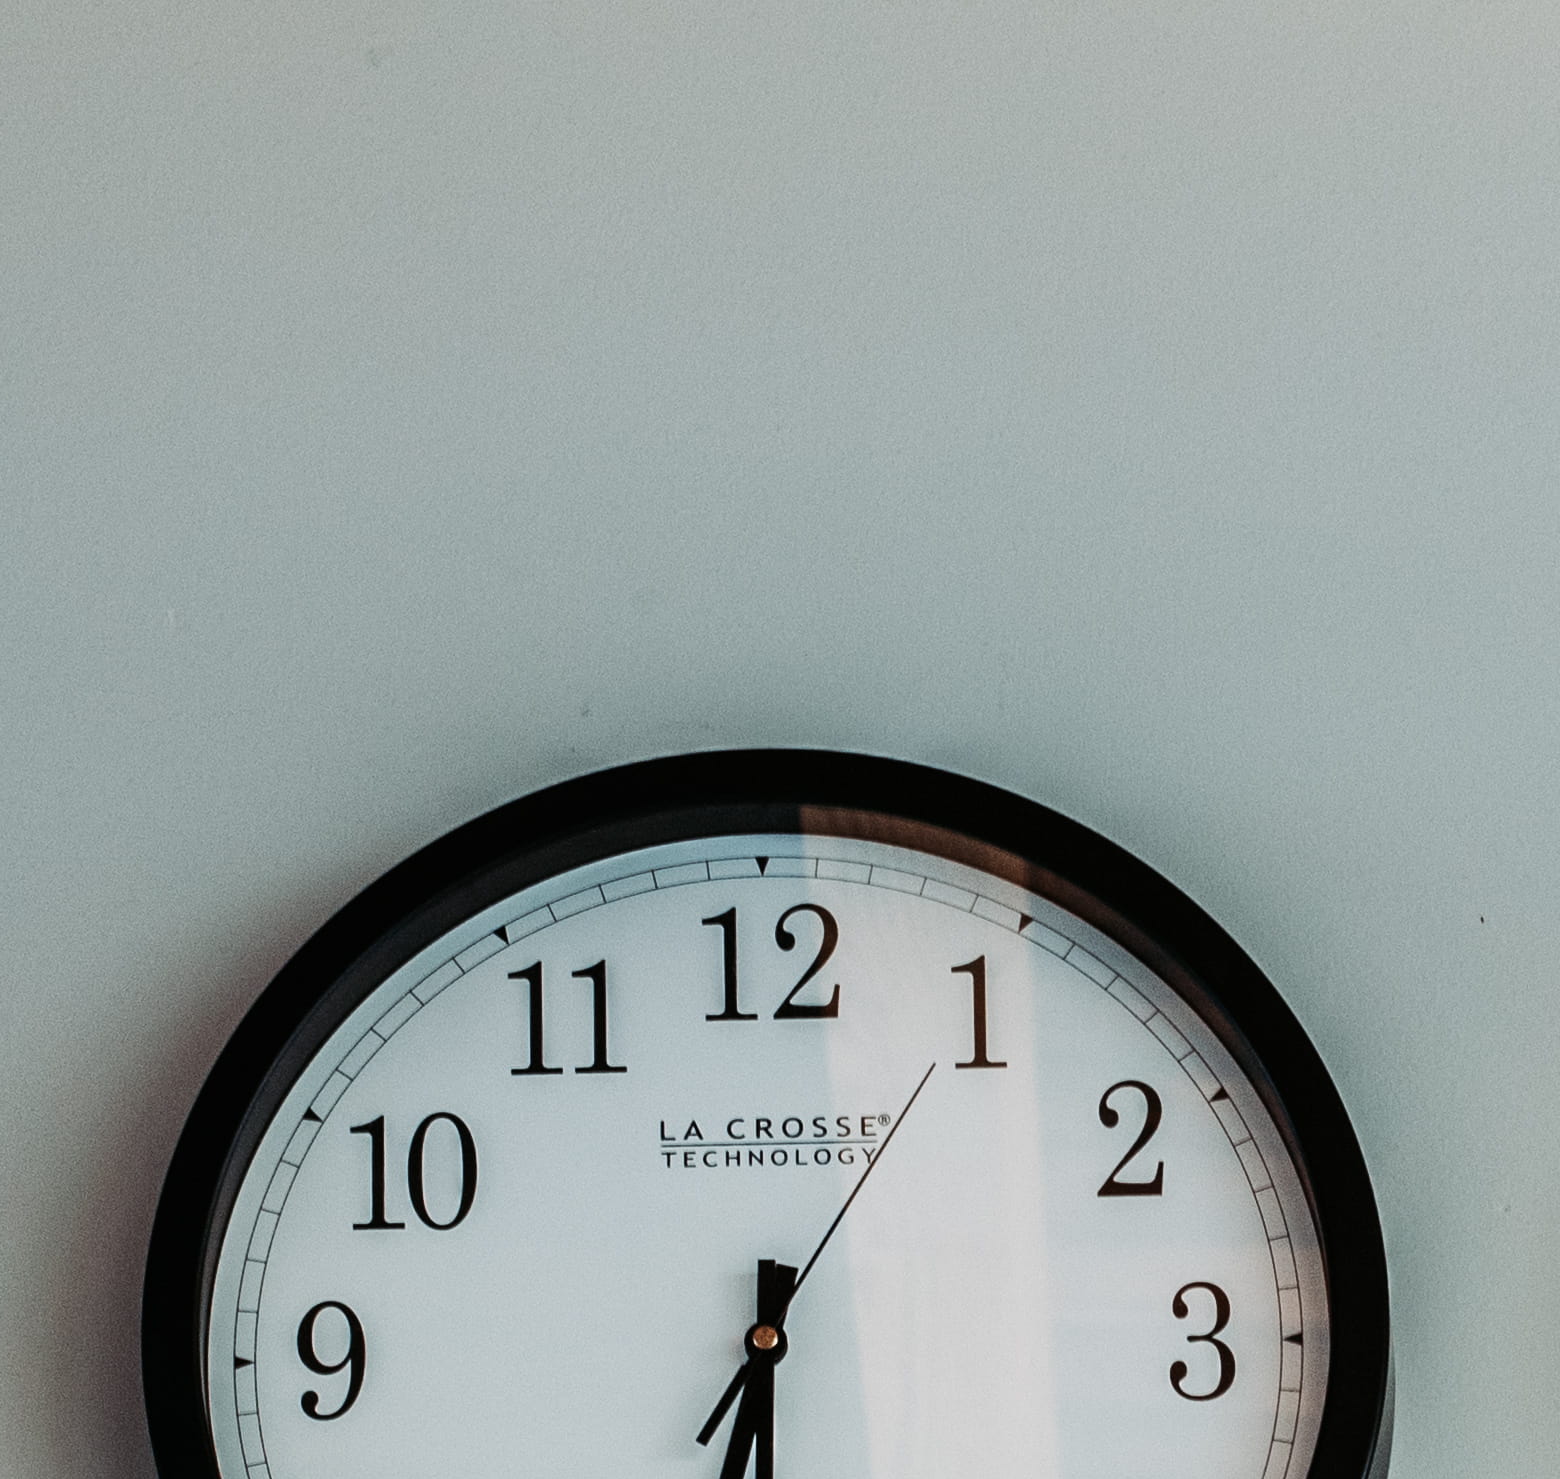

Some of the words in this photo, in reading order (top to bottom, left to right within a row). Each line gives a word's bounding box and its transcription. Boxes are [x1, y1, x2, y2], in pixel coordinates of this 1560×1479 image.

[508, 959, 627, 1075] 11
[702, 903, 840, 1021] 12
[951, 955, 1007, 1069] 1
[350, 1112, 477, 1230] 10
[660, 1120, 703, 1141] LA
[661, 1147, 877, 1168] TECHNOLOGY
[1097, 1080, 1164, 1197] 2
[297, 1301, 365, 1420] 9
[1170, 1282, 1235, 1401] 3
